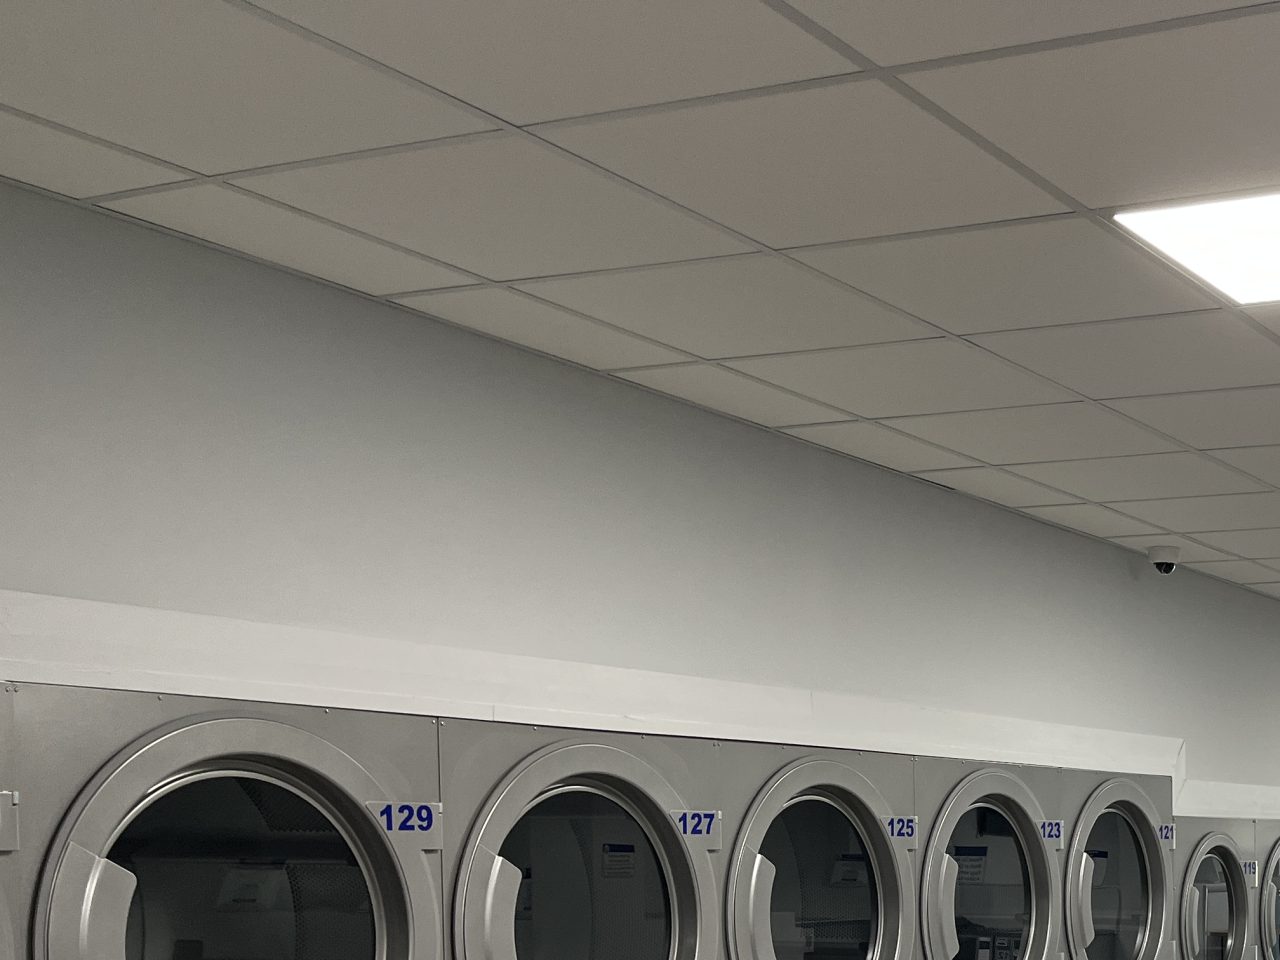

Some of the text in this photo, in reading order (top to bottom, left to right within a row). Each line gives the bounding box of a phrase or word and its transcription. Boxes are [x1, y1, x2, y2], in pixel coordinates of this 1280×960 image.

[379, 804, 434, 832] 129
[678, 812, 715, 835] 127
[887, 817, 915, 838] 125
[1040, 821, 1062, 839] 123
[1158, 824, 1174, 840] 121
[1243, 861, 1257, 876] 119
